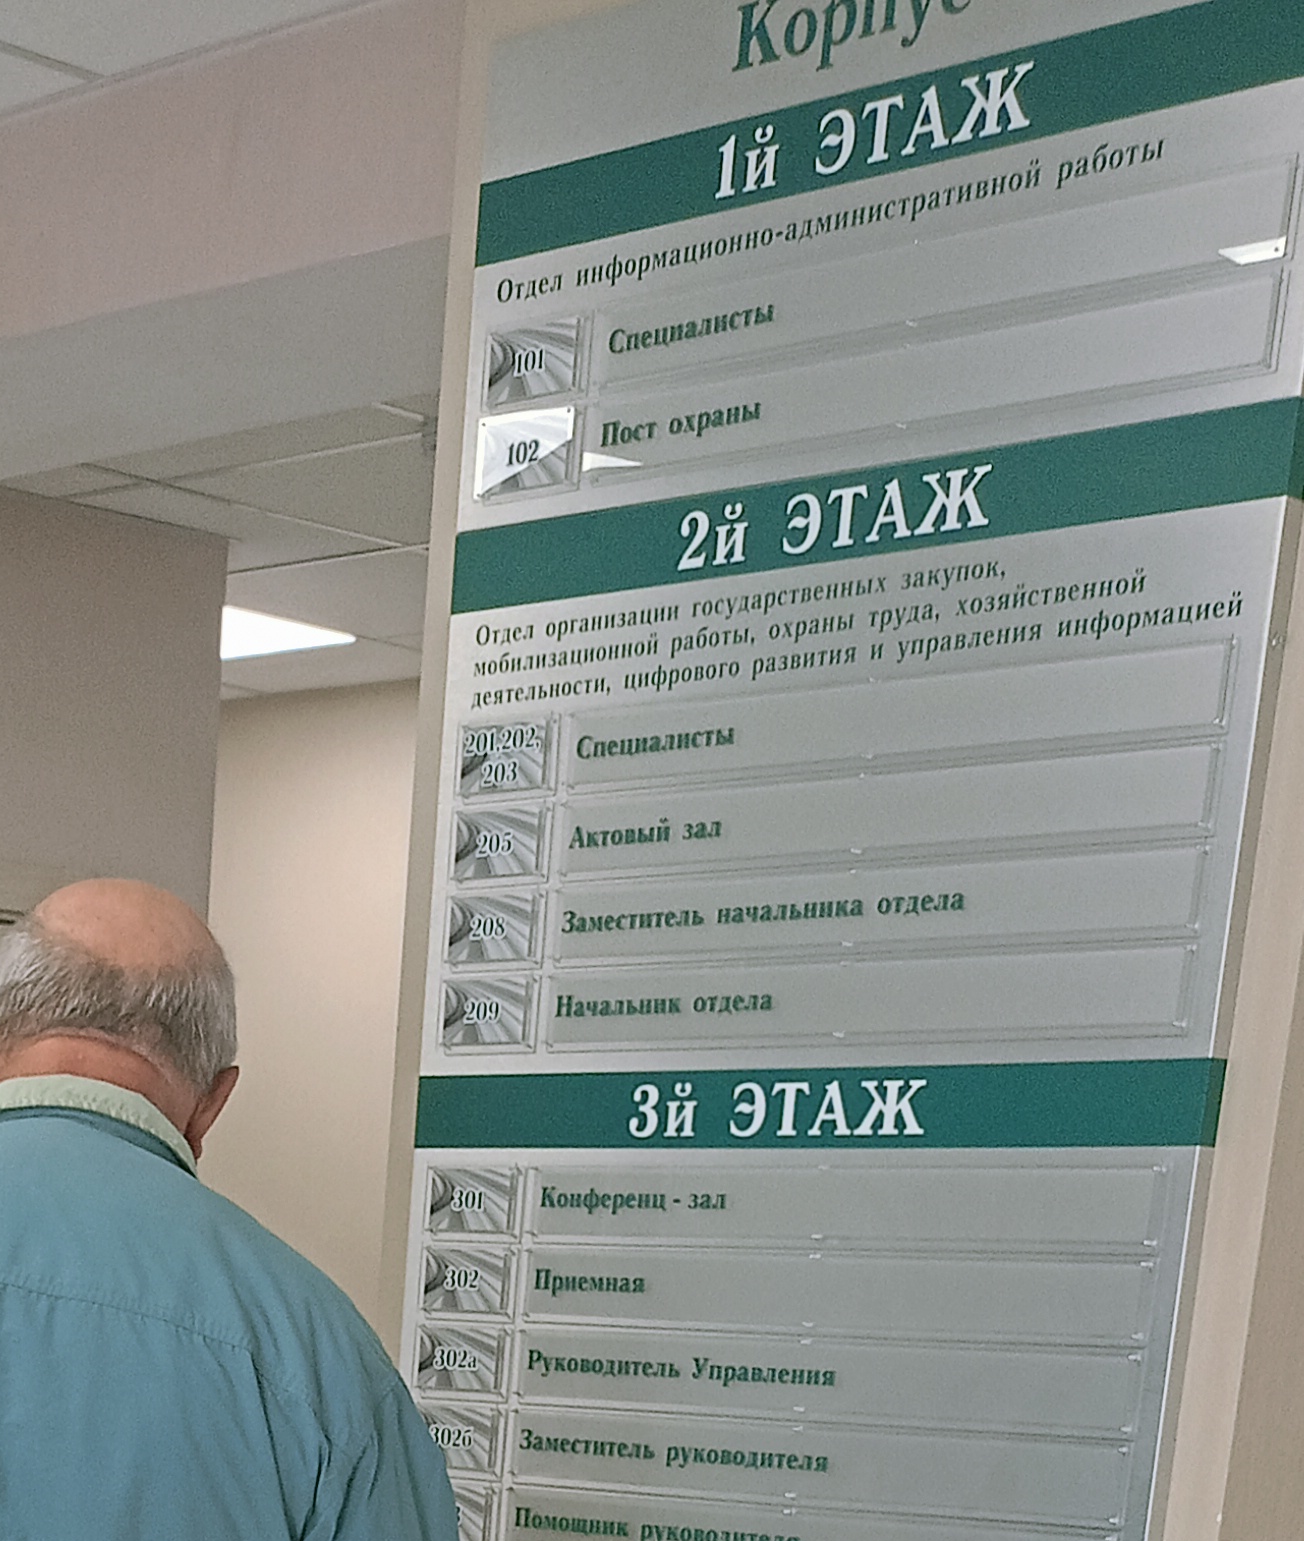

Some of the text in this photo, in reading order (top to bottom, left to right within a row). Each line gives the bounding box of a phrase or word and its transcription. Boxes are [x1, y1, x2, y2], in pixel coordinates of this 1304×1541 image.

[732, 0, 971, 72] Корпу
[715, 61, 1035, 200] 1й ЭТАЖ
[497, 138, 1166, 303] Отдел информационно-административной работы
[608, 304, 775, 354] Специалисты
[515, 349, 544, 373] 101
[600, 402, 762, 448] Пост охраны
[506, 440, 540, 466] 102
[676, 463, 994, 571] 2й ЭТАЖ
[475, 559, 1007, 649] Отдел организации государственных закупок,
[473, 567, 1147, 679] мобилизационной работы, охраны труда, хозяйственной
[471, 590, 1244, 710] деятельности, цифрового развития и управления информацией
[576, 727, 735, 760] Специалисты
[482, 761, 518, 785] 203
[477, 832, 512, 855] 205
[569, 817, 722, 849] Актовый зал
[470, 917, 505, 940] 208
[560, 891, 965, 934] Заместитель начальника отдела
[463, 1000, 500, 1023] 209
[554, 993, 773, 1019] Начальник отдела
[628, 1078, 927, 1139] 3й ЭТАЖ
[452, 1189, 484, 1211] 301
[540, 1186, 666, 1214] Конференц
[687, 1190, 727, 1211] зал
[444, 1268, 480, 1290] 302
[534, 1268, 646, 1294] Приемная
[433, 1349, 477, 1370] 302а
[527, 1348, 837, 1387] Руководитель Управления
[519, 1429, 829, 1473] Заместитель руководителя
[514, 1506, 629, 1537] Помощник
